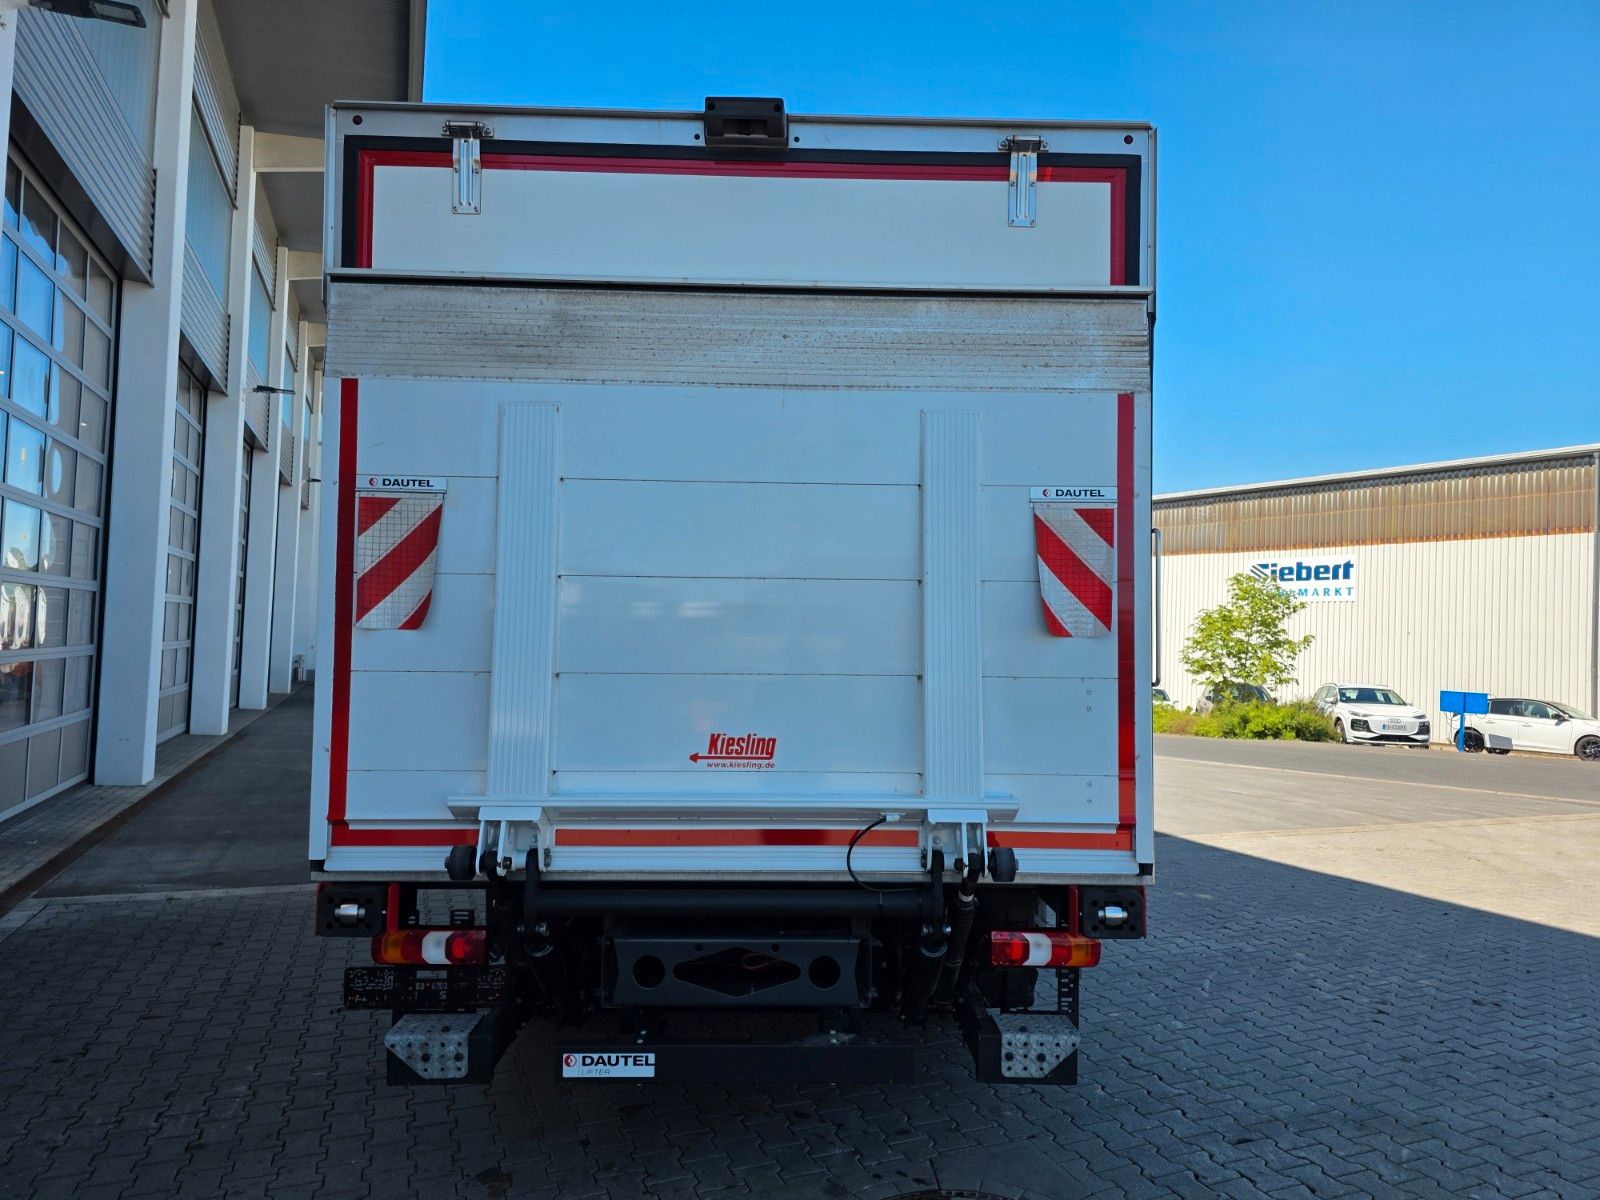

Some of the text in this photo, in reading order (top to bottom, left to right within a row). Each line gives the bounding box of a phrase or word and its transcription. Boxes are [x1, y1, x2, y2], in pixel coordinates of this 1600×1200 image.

[382, 478, 434, 488] DAUTEL
[1055, 489, 1105, 497] DAUTEL
[708, 733, 777, 760] Kiesling
[706, 761, 775, 769] www.kiesling.de
[581, 1055, 655, 1067] DAUTEL
[581, 1068, 610, 1076] LIFTER
